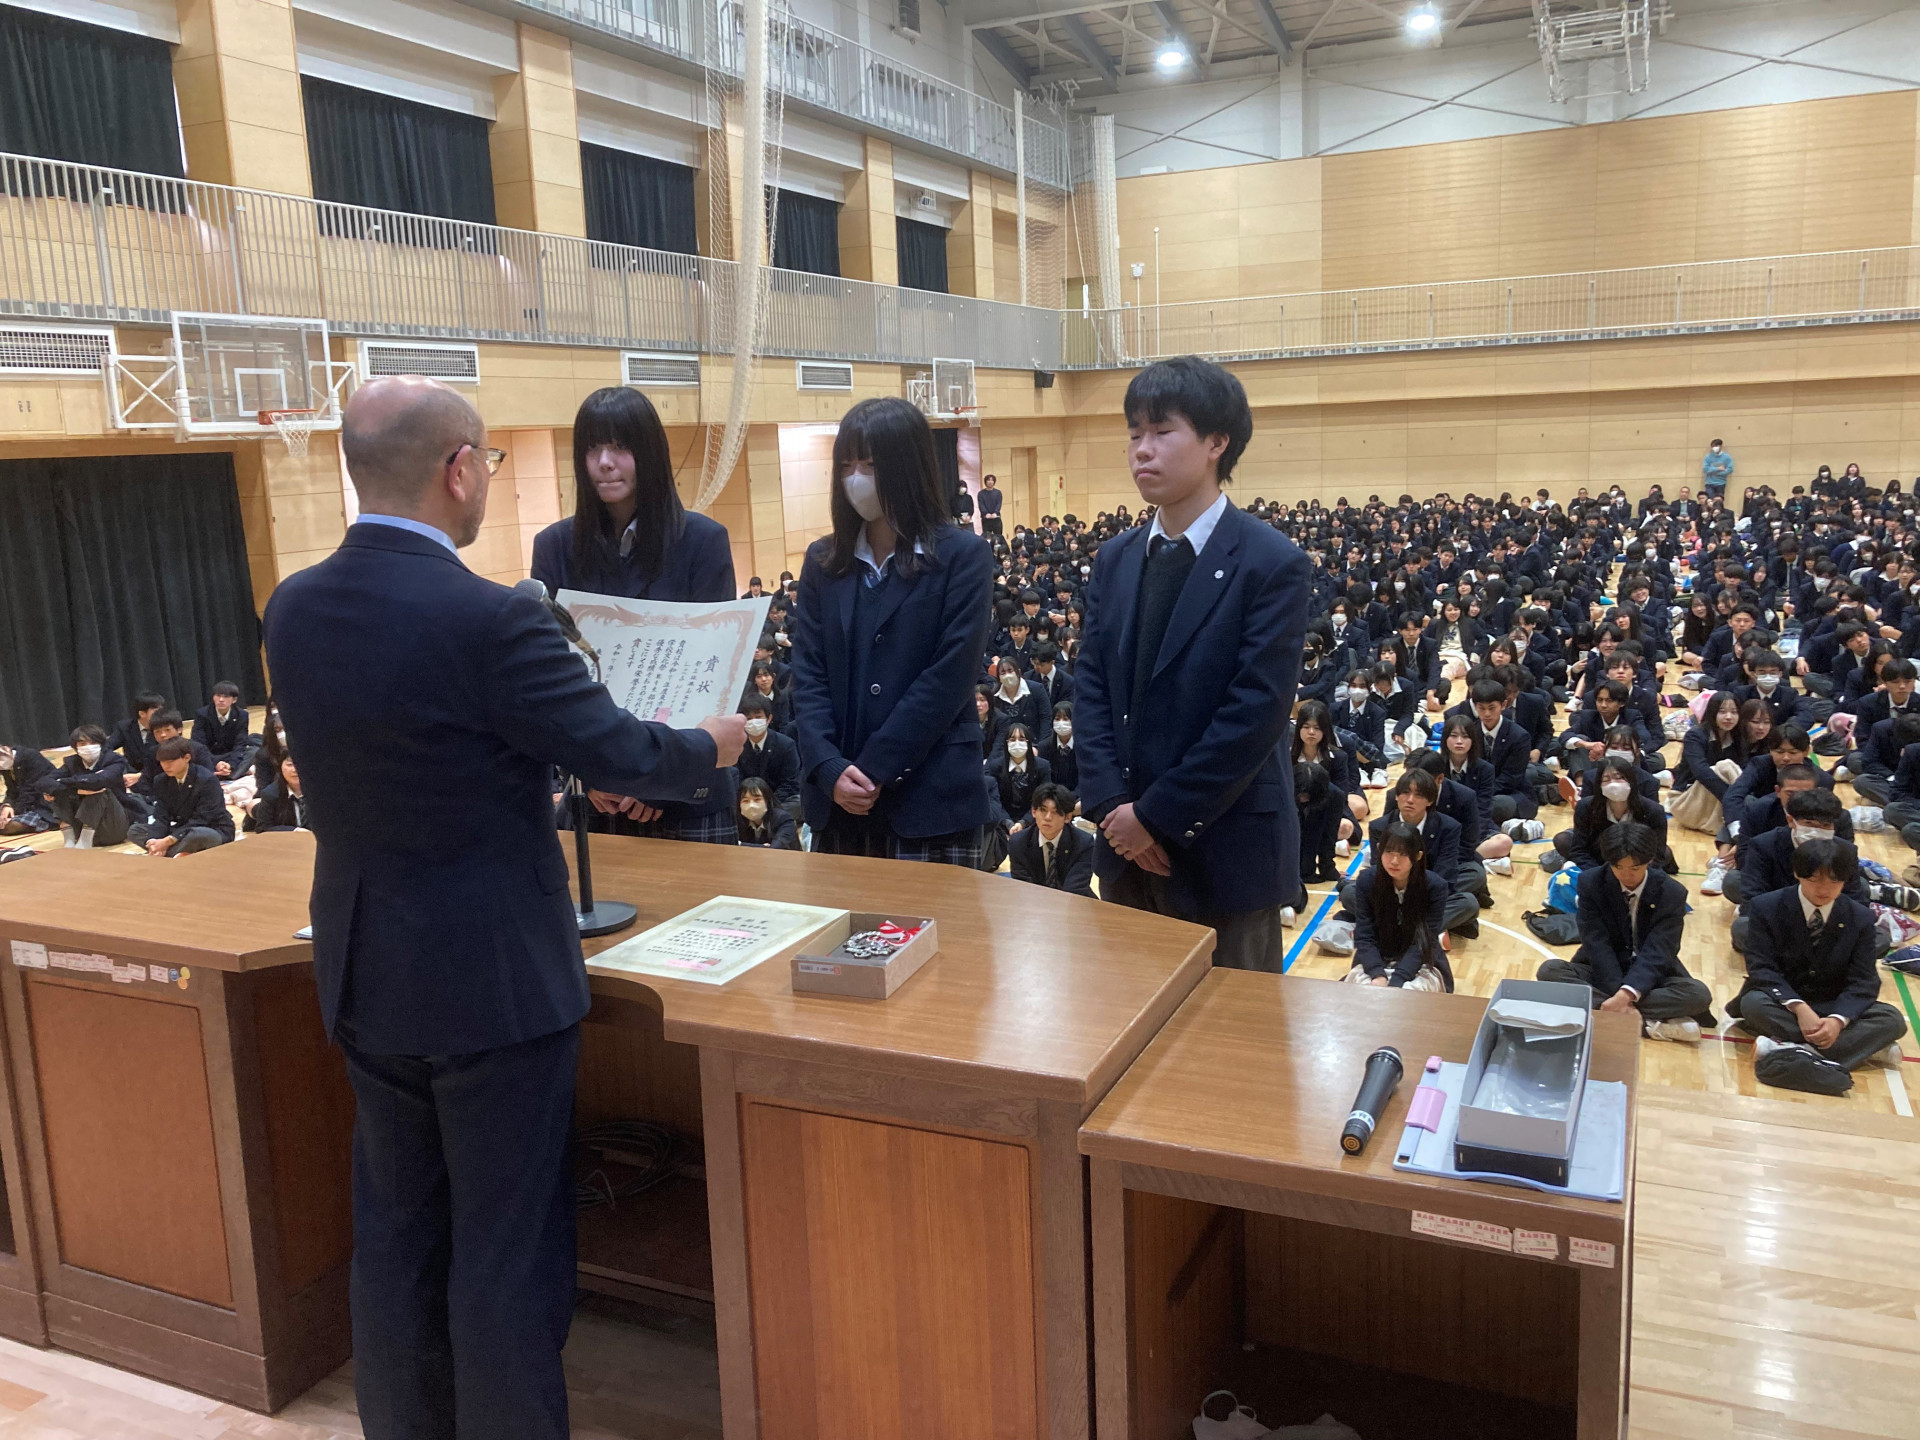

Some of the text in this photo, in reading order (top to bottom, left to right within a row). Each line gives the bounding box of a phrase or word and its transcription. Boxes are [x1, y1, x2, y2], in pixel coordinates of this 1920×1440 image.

[626, 637, 643, 669] 賞します
[696, 654, 720, 693] 賞状
